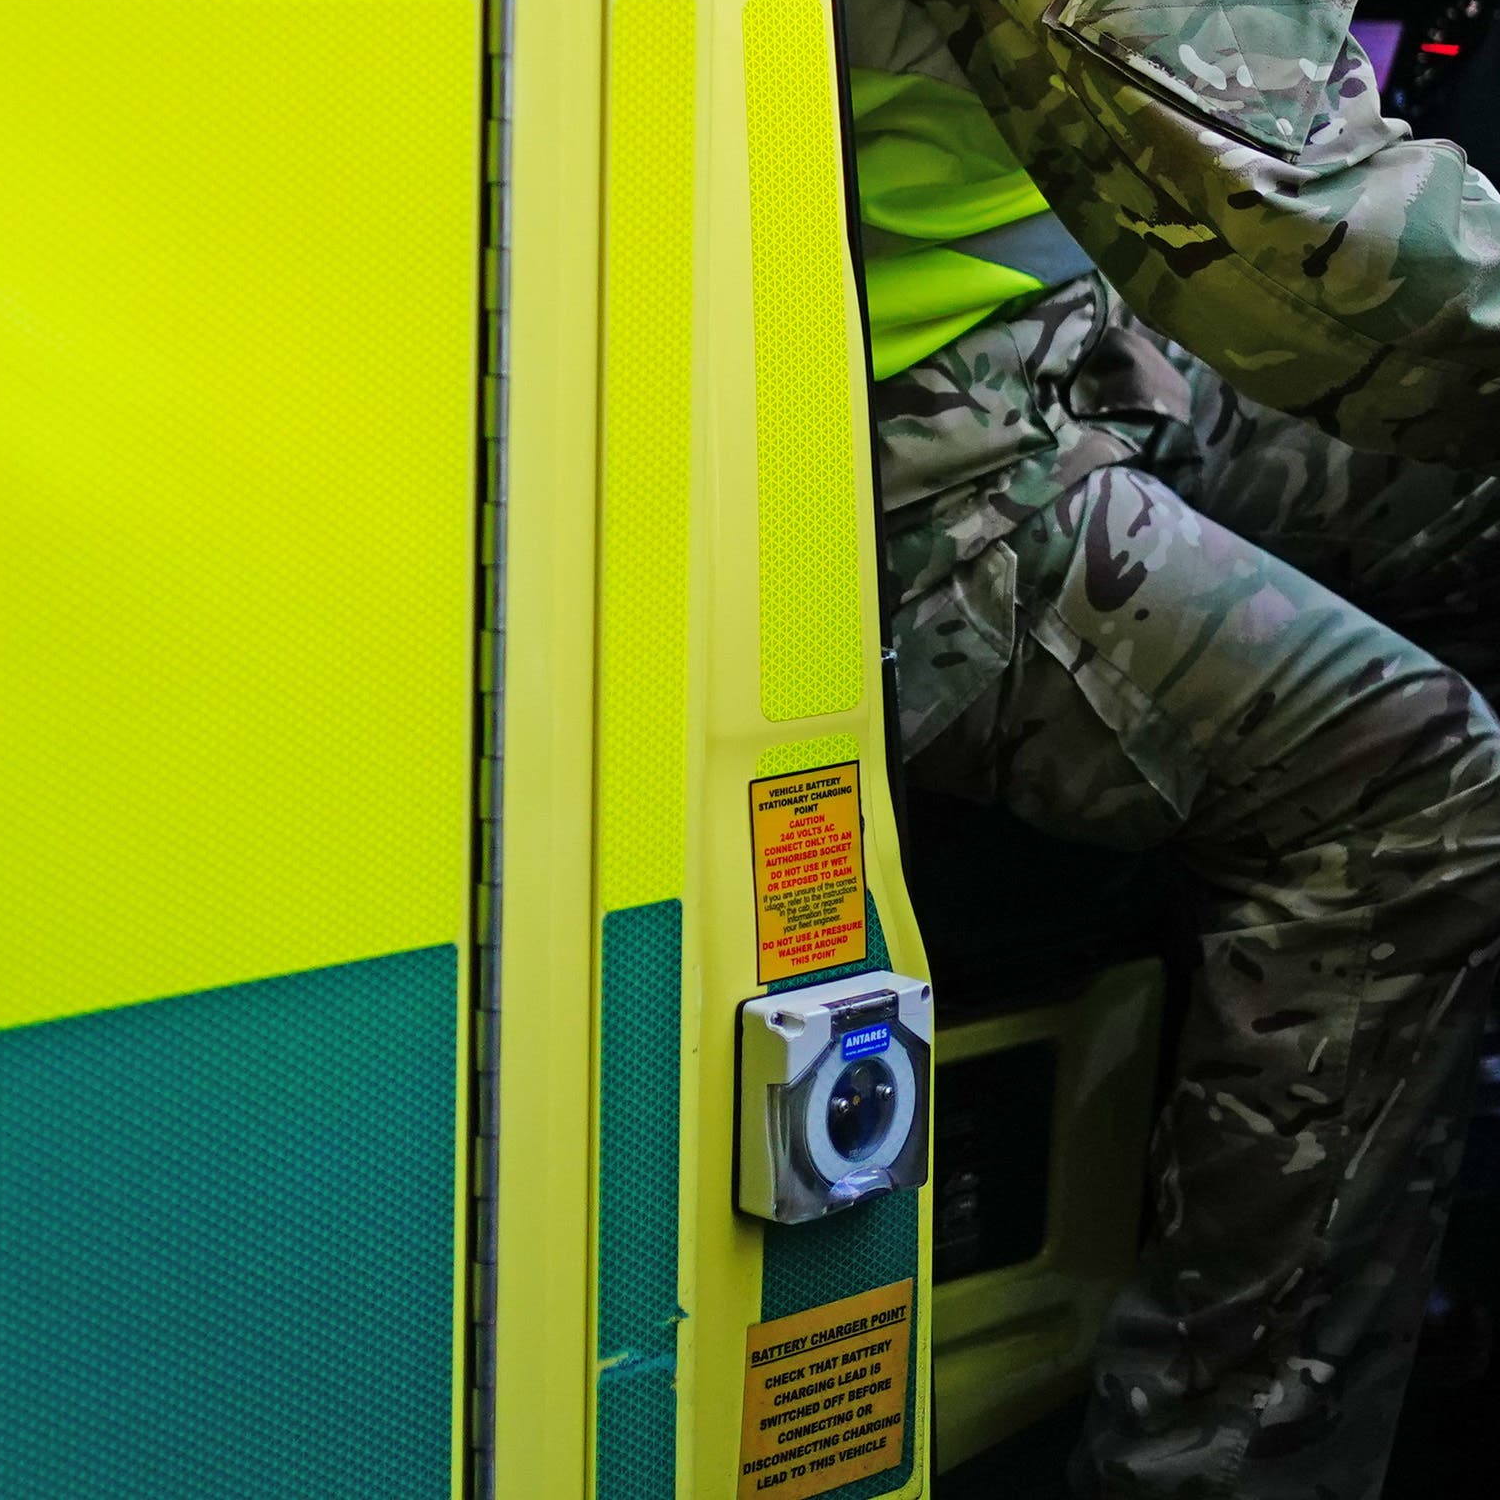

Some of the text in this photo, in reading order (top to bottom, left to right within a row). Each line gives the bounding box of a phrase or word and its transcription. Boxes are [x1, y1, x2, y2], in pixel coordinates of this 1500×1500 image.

[759, 786, 852, 811] STATIONARY CHARGING
[769, 777, 841, 797] VEHICLE BATTERY
[790, 814, 825, 828] CAUTION
[795, 804, 818, 815] POINT
[765, 842, 802, 856] CONNECT
[805, 837, 826, 847] ONLY
[841, 831, 852, 840] AN
[780, 824, 835, 841] 240 VOLTS AC
[766, 842, 851, 867] AUTHORISED SOCKET
[768, 867, 852, 892] OR EXPOSED TO RAIN
[771, 856, 847, 880] DO NOT USE IF WET
[769, 894, 781, 902] you
[795, 887, 815, 896] unsure
[836, 877, 856, 887] correct
[788, 911, 822, 922] information
[763, 920, 863, 950] DO NOT USE A PRESSURE
[779, 935, 848, 957] WASHER AROUND
[791, 949, 836, 966] THIS POINT
[846, 1028, 887, 1048] ANTARES
[751, 1306, 906, 1364] BATTERY CHARGER POINT
[765, 1339, 892, 1389] CHECK THAT BATTERY
[774, 1363, 881, 1406] CHARGING LEAD IS
[760, 1378, 892, 1430] SWITCHED OFF BEFORE
[778, 1404, 873, 1444] CONNECTING OR
[743, 1413, 901, 1475] DISCONNECTING CHARGING
[757, 1437, 887, 1490] LEAD TO THIS VEHICLE
